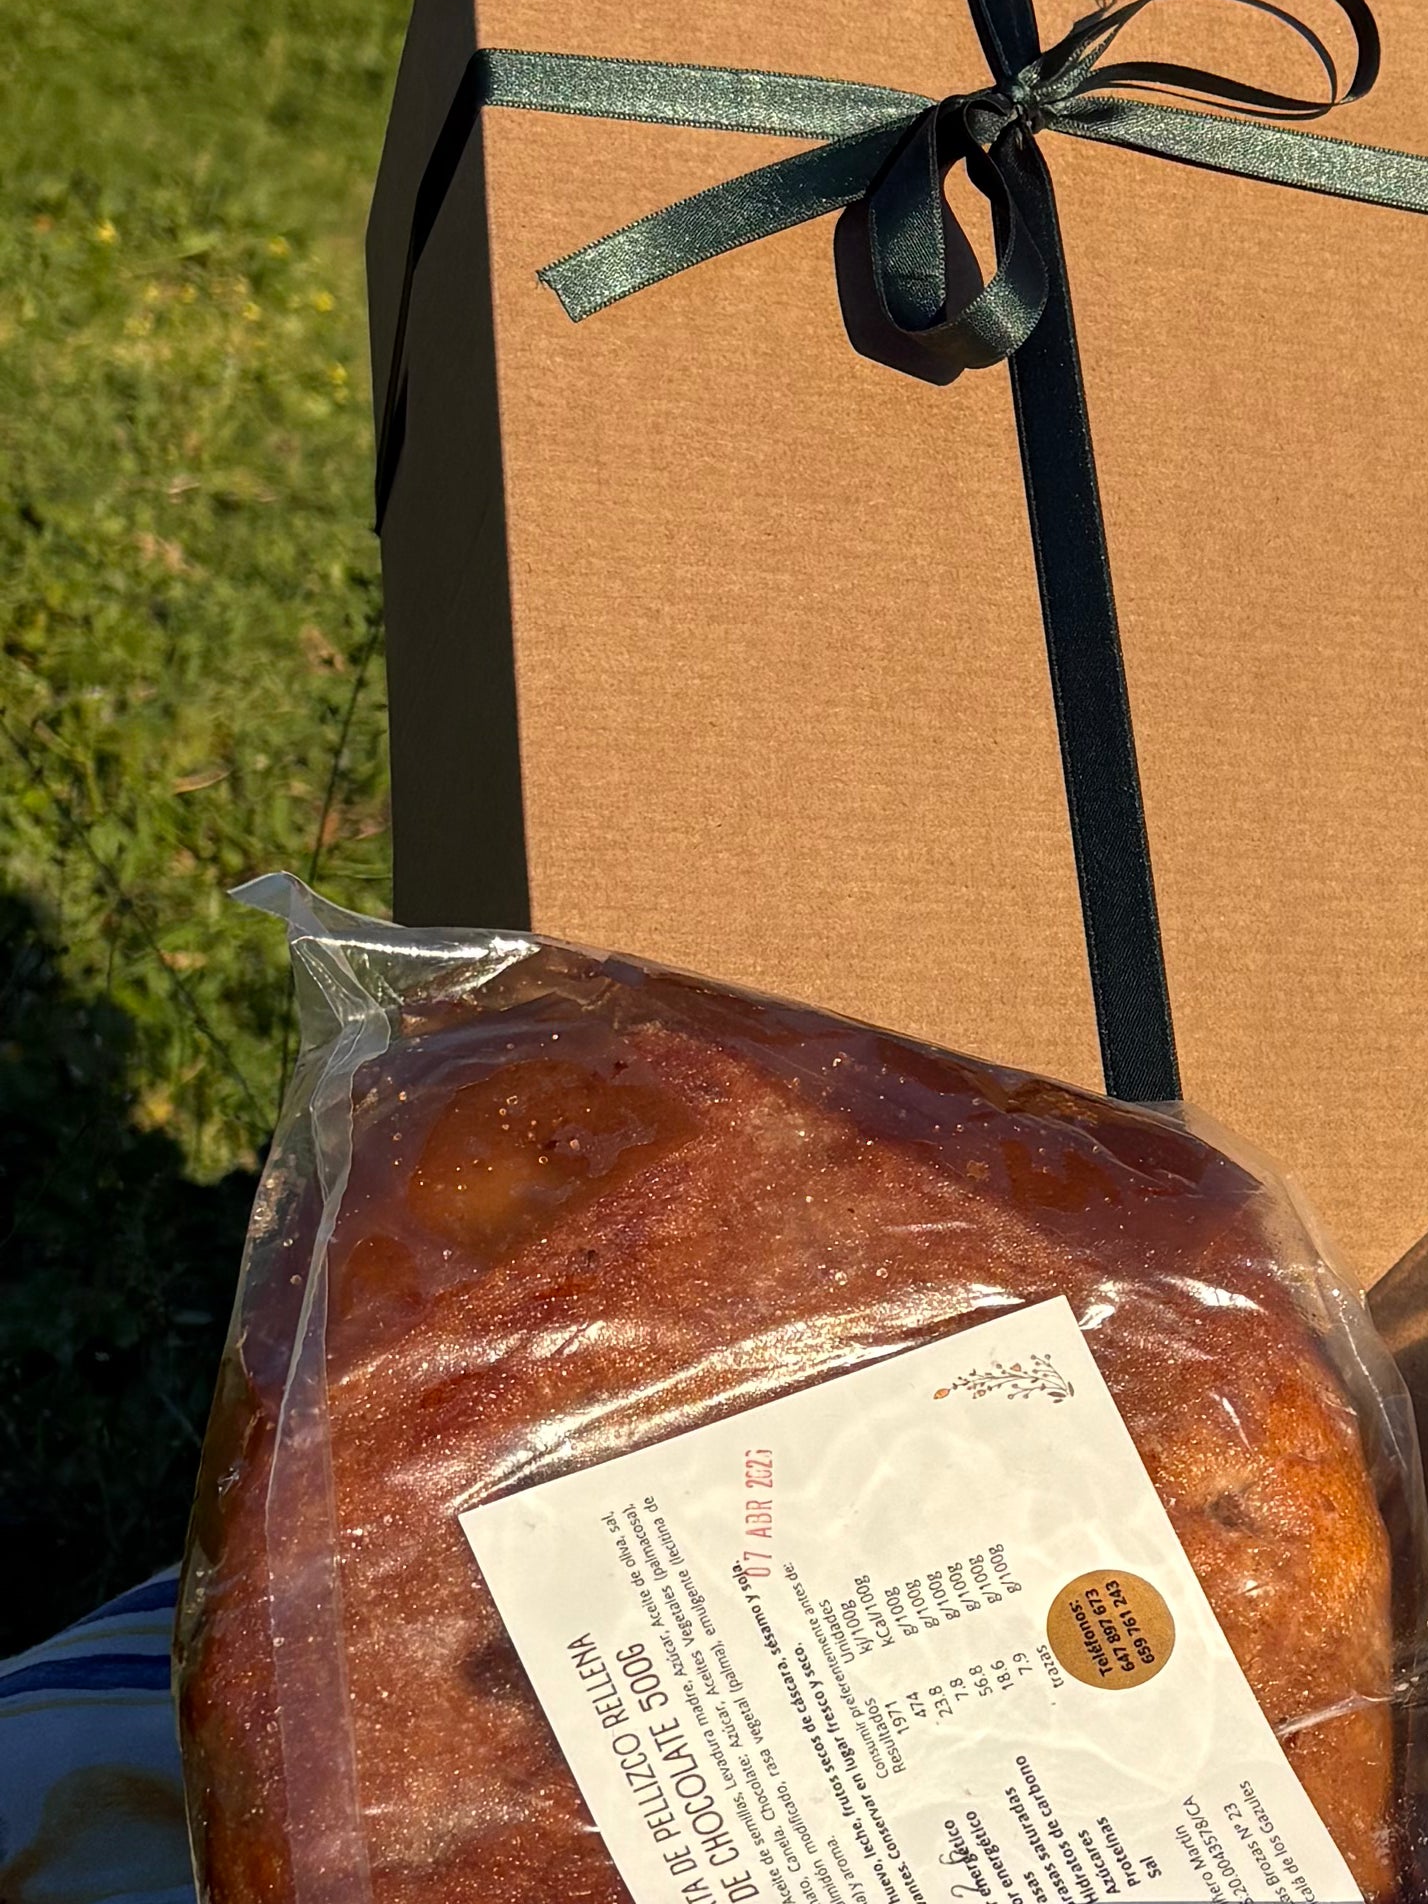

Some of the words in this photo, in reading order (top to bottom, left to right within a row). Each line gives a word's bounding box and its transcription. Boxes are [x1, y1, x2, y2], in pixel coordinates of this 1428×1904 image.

[644, 1496, 657, 1511] de
[745, 1499, 772, 1537] ABR
[616, 1536, 635, 1567] oliva,
[654, 1517, 684, 1564] (lecitina
[631, 1571, 644, 1585] de
[743, 1550, 771, 1575] 07
[640, 1589, 663, 1626] Aceite
[678, 1569, 715, 1635] emulgente
[793, 1582, 813, 1613] antes
[854, 1575, 894, 1646] kCal/100g
[1085, 1588, 1106, 1615] 673
[1105, 1580, 1127, 1607] 243
[661, 1585, 694, 1646] Vegetales
[751, 1605, 780, 1654] sésamo
[819, 1599, 854, 1663] Unidades
[1098, 1619, 1120, 1643] 897
[1119, 1610, 1140, 1636] 761
[659, 1630, 686, 1675] Azúcar,
[1069, 1600, 1112, 1676] Teléfonos:
[1112, 1647, 1134, 1671] 647
[1133, 1637, 1154, 1663] 659
[567, 1633, 628, 1728] RELLENA
[616, 1643, 668, 1711] 500G
[691, 1650, 718, 1694] Aceites
[710, 1640, 742, 1692] (palma),
[777, 1657, 806, 1712] cáscara,
[809, 1618, 864, 1717] preferentemente
[969, 1665, 992, 1696] 56.8
[990, 1660, 1013, 1689] 18.6
[1013, 1653, 1032, 1675] 7.9
[683, 1680, 708, 1725] madre,
[733, 1697, 762, 1743] vegetal
[814, 1691, 839, 1732] fresco
[906, 1692, 925, 1716] 474
[929, 1686, 952, 1717] 23.8
[715, 1701, 742, 1746] Azúcar,
[802, 1715, 815, 1732] de
[864, 1697, 905, 1773] Resultados
[703, 1729, 736, 1789] Levadura
[760, 1748, 779, 1776] rasa
[810, 1735, 834, 1772] secos
[834, 1737, 856, 1771] lugar
[856, 1722, 888, 1778] Consumir
[612, 1733, 680, 1842] PELLIZCO
[649, 1717, 738, 1865] CHOCOLATE
[829, 1775, 854, 1816] frutos
[852, 1773, 865, 1789] en
[1016, 1756, 1051, 1816] carbono
[733, 1792, 764, 1845] semillas,
[777, 1781, 817, 1853] modificado,
[861, 1795, 899, 1858] Conservar
[1224, 1803, 1241, 1820] 23
[1240, 1780, 1273, 1833] Gazules
[852, 1818, 875, 1858] leche,
[966, 1811, 1012, 1887] energético
[1047, 1819, 1063, 1837] de
[1176, 1825, 1205, 1869] Martín
[1269, 1835, 1286, 1856] los
[663, 1845, 697, 1875] DE
[760, 1849, 773, 1864] de
[1055, 1840, 1101, 1904] Hidratos
[1078, 1830, 1120, 1893] Azúcares
[1096, 1817, 1140, 1886] Proteínas
[1248, 1841, 1279, 1885] Brozas
[1282, 1857, 1298, 1873] de
[720, 1870, 759, 1902] DE
[769, 1868, 795, 1903] Aceite
[873, 1859, 899, 1904] huevo,
